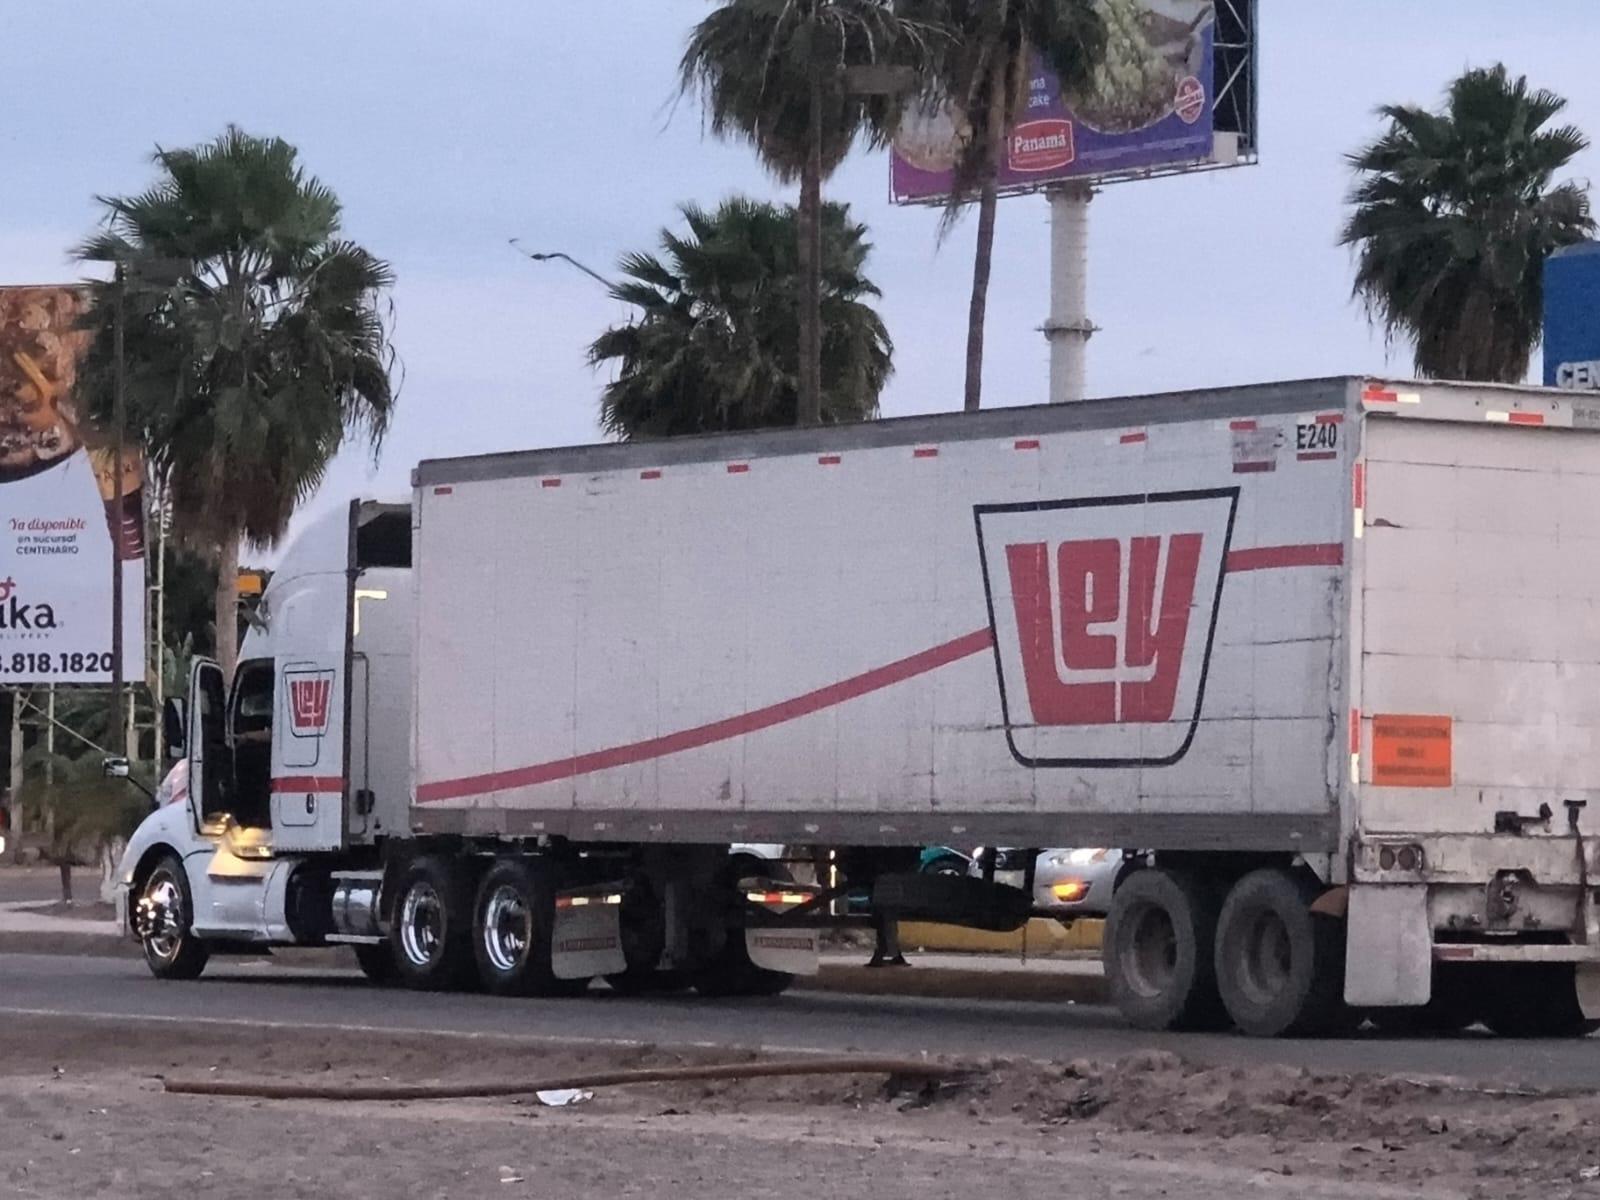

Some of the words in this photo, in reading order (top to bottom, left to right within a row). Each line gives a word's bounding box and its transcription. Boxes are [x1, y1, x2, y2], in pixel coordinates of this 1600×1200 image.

[1014, 128, 1066, 154] Panamá
[1297, 422, 1337, 449] E240
[9, 518, 25, 530] Ya
[28, 518, 86, 533] disponible
[33, 534, 76, 543] sucursal
[16, 545, 79, 554] CENTENARIO
[0, 652, 115, 673] .818.1820
